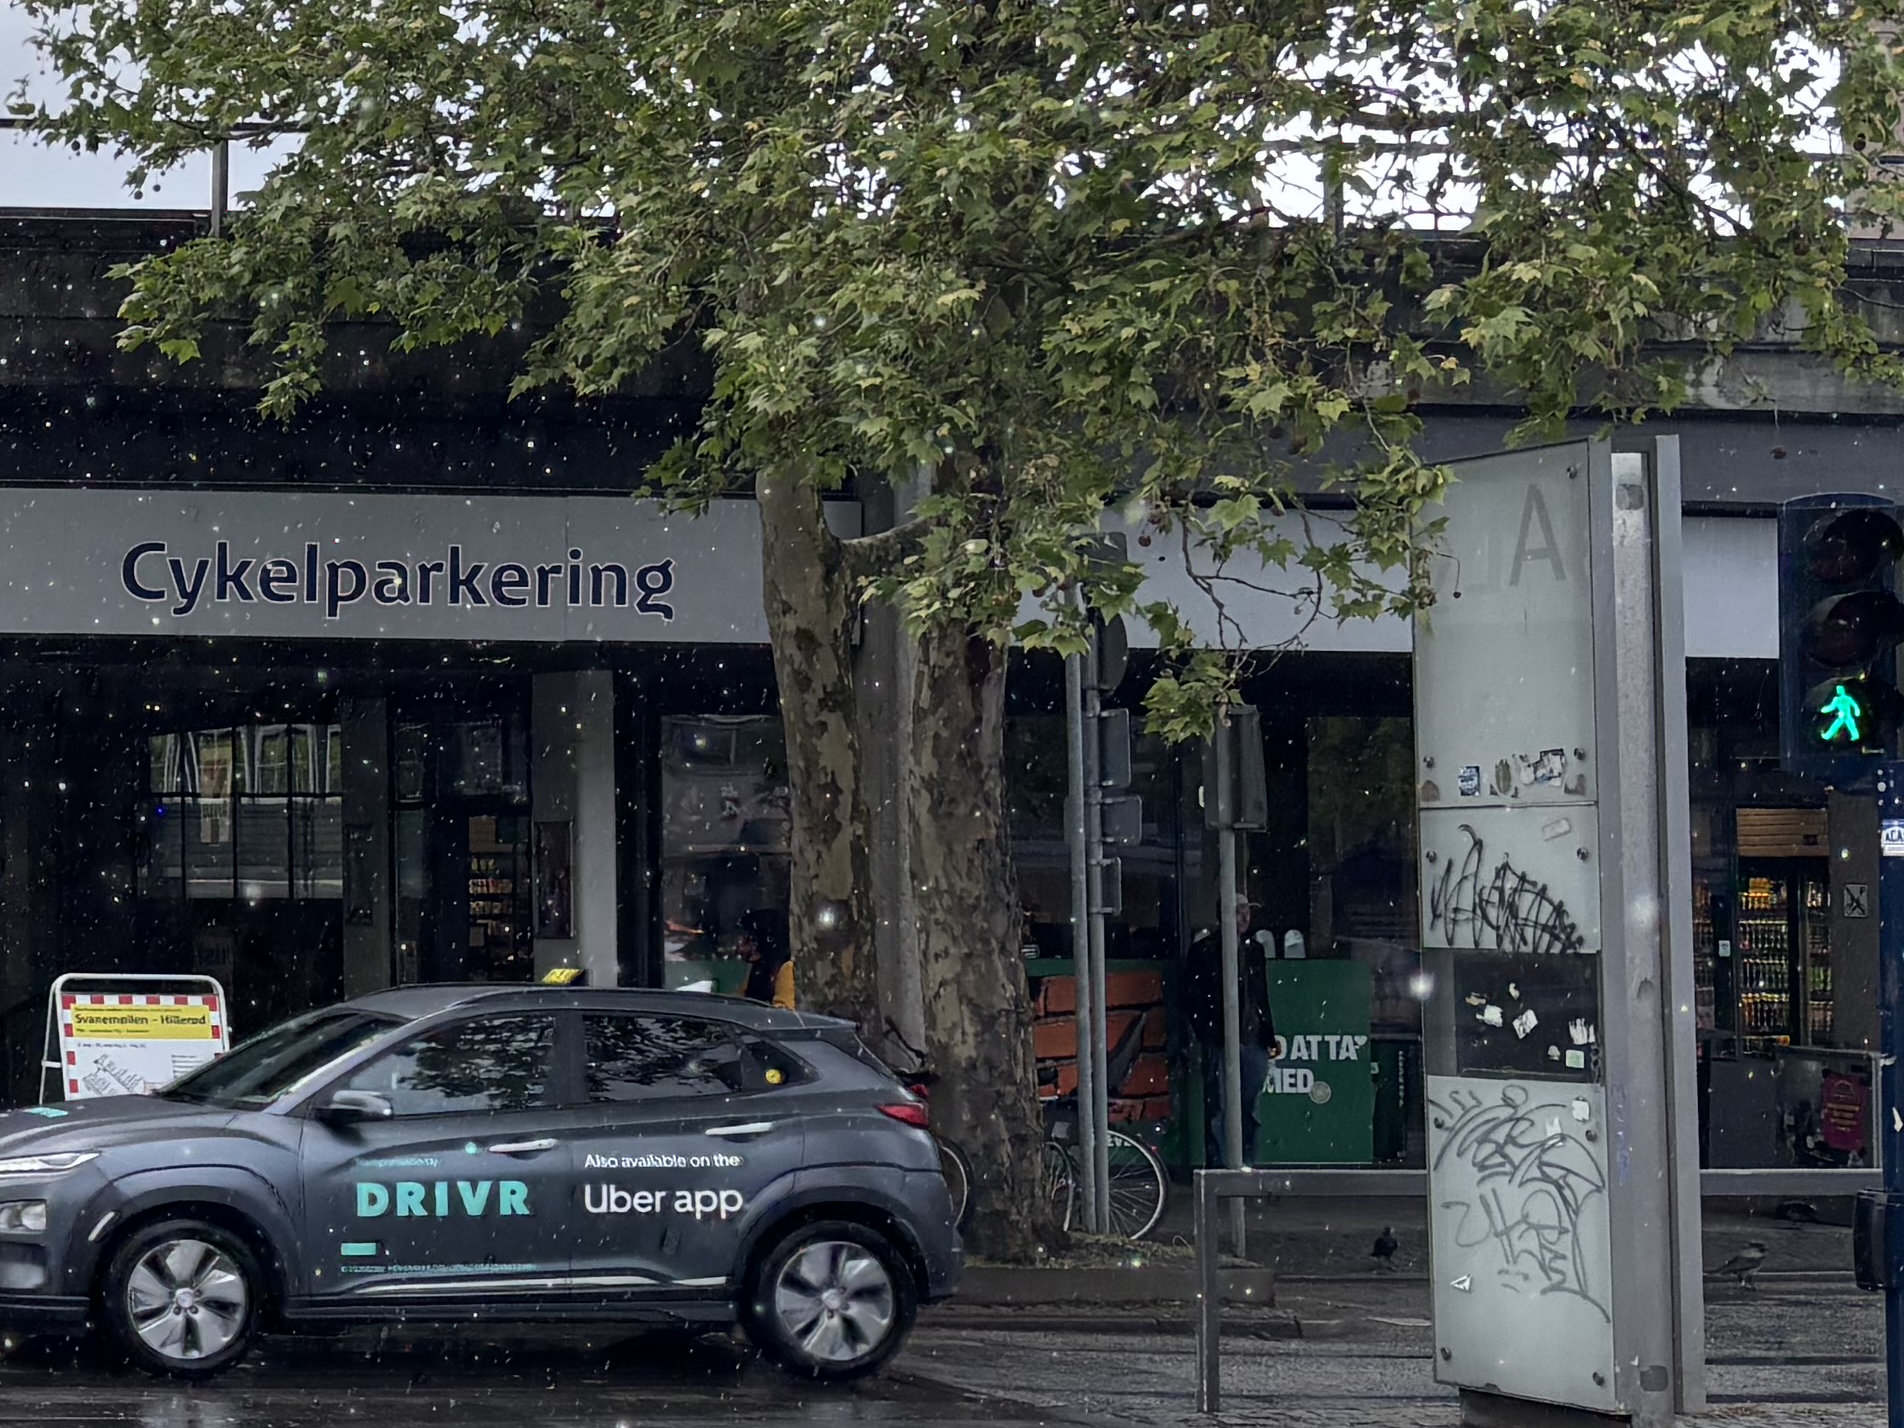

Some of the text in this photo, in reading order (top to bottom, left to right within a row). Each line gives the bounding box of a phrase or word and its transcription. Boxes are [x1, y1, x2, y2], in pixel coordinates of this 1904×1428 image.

[121, 541, 675, 621] Cykelparkering
[585, 1154, 740, 1168] Also available on the
[357, 1181, 530, 1217] DRIVR
[584, 1184, 743, 1220] Uber app
